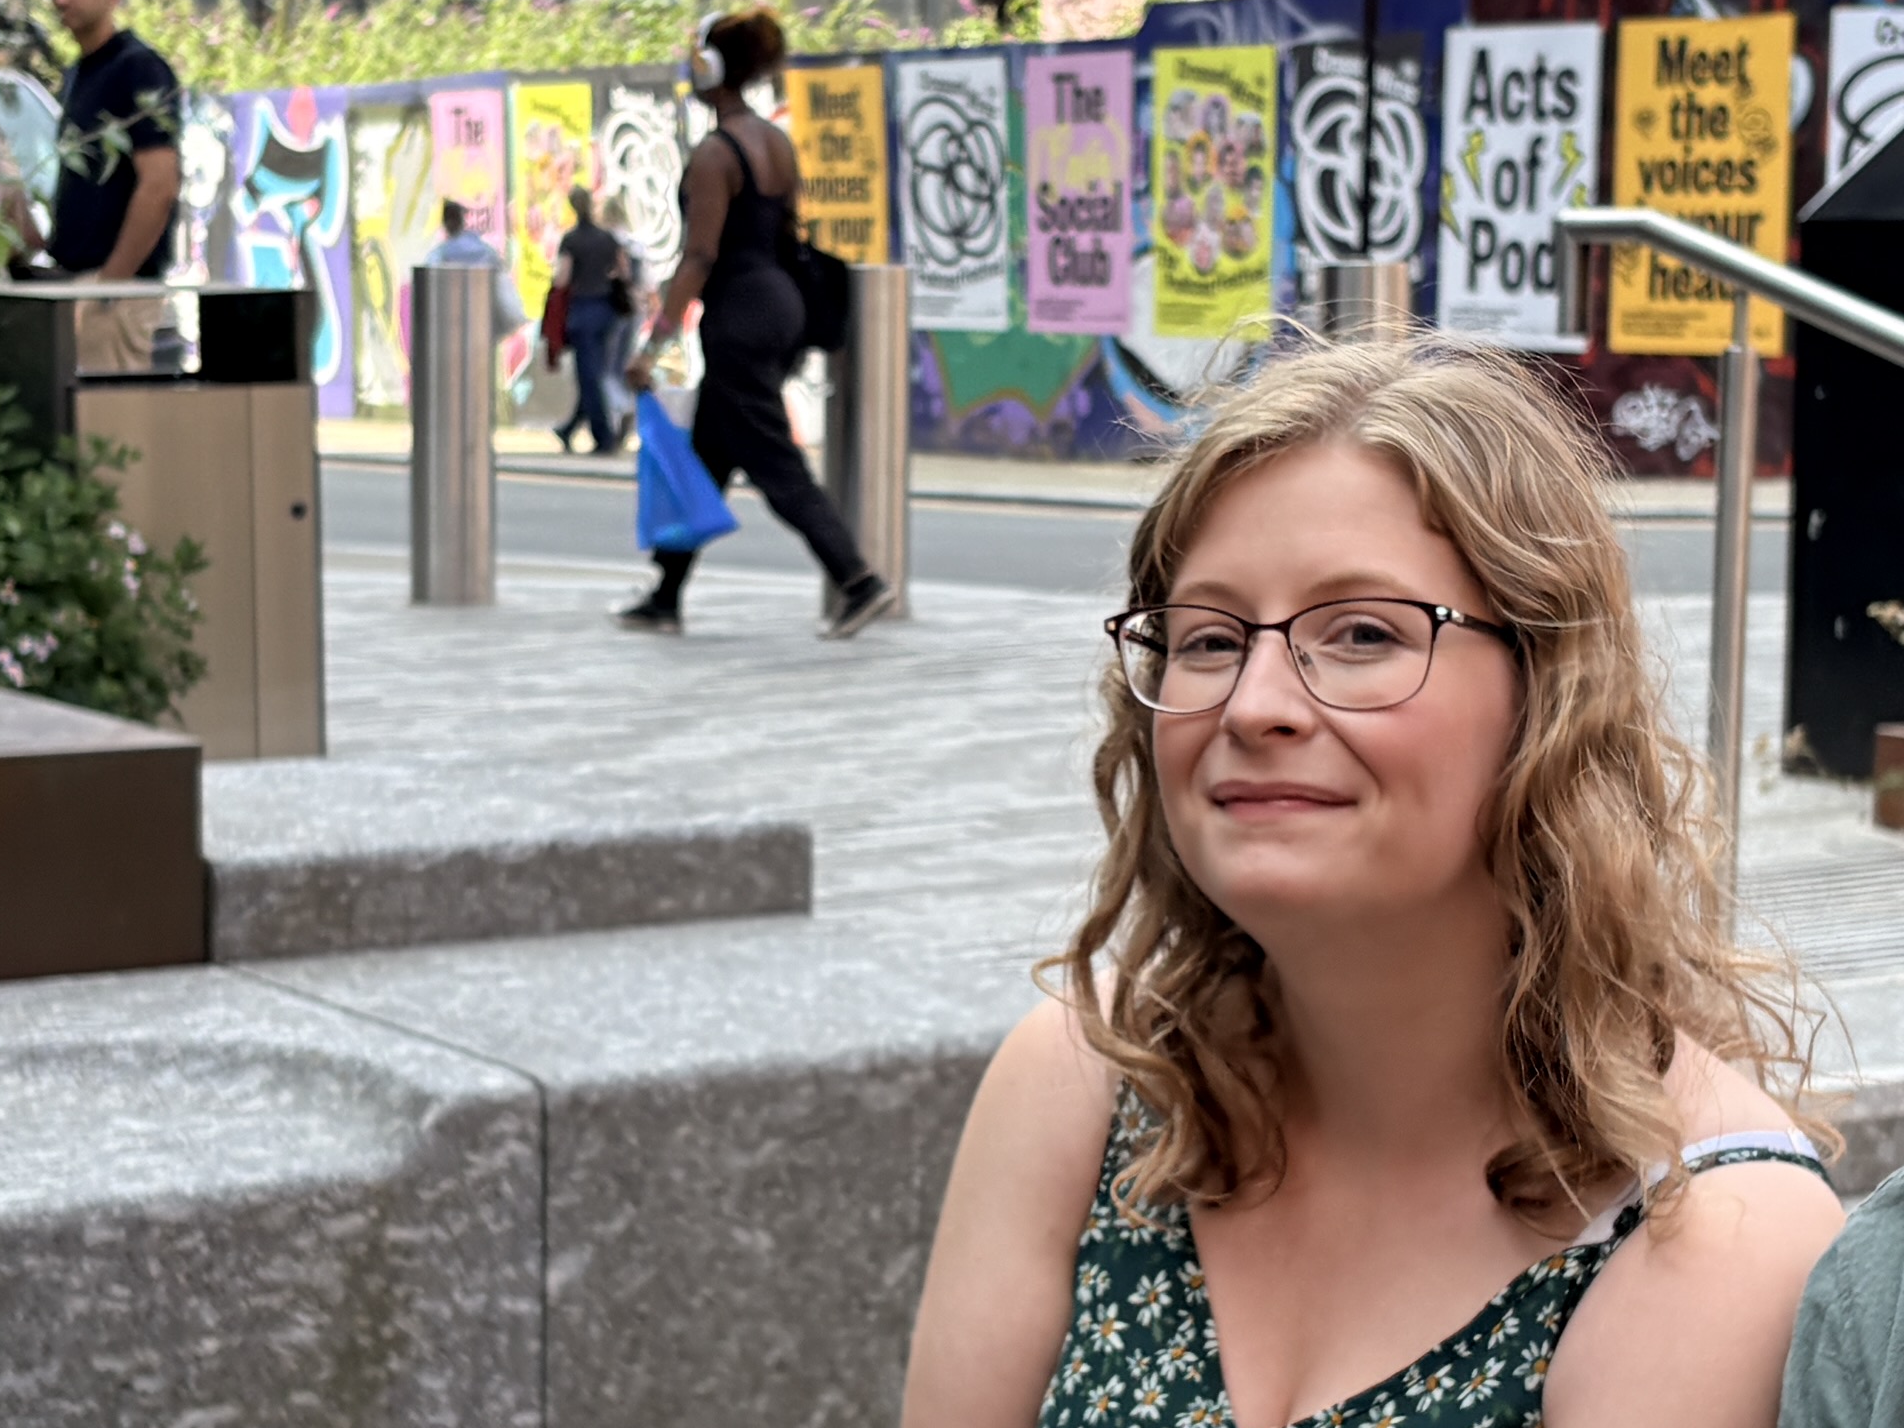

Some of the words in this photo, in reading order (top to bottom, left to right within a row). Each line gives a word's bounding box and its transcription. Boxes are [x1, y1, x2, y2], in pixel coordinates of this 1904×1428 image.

[1464, 47, 1578, 123] Acts
[1655, 35, 1751, 88] Meet
[1052, 71, 1105, 125] The
[1669, 91, 1730, 142] the
[1493, 134, 1546, 214] of
[1637, 143, 1758, 195] voices
[1036, 180, 1124, 234] Social
[1048, 235, 1112, 287] Club
